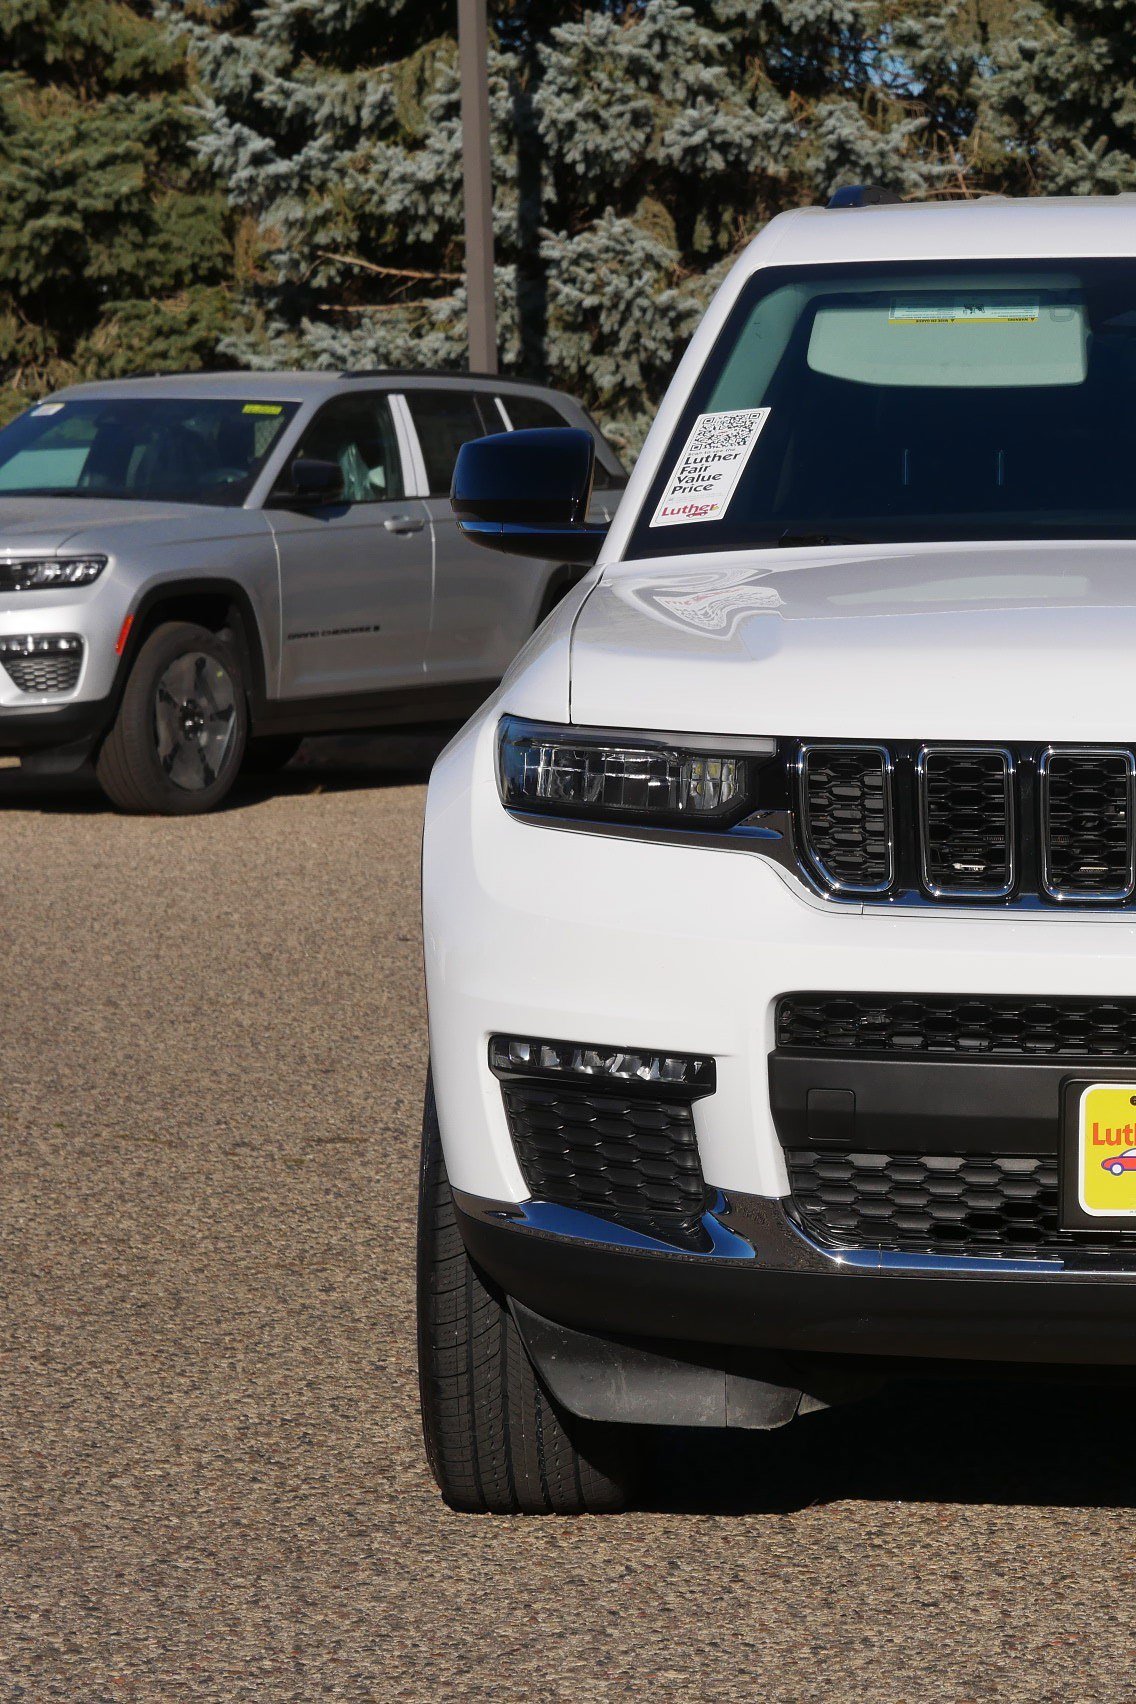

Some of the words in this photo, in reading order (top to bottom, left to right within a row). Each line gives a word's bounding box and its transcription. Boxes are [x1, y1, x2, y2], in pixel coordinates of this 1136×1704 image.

[684, 453, 741, 465] Luther
[680, 464, 711, 475] Fair
[677, 473, 723, 485] Value
[671, 483, 714, 495] Price
[661, 503, 718, 516] Luther
